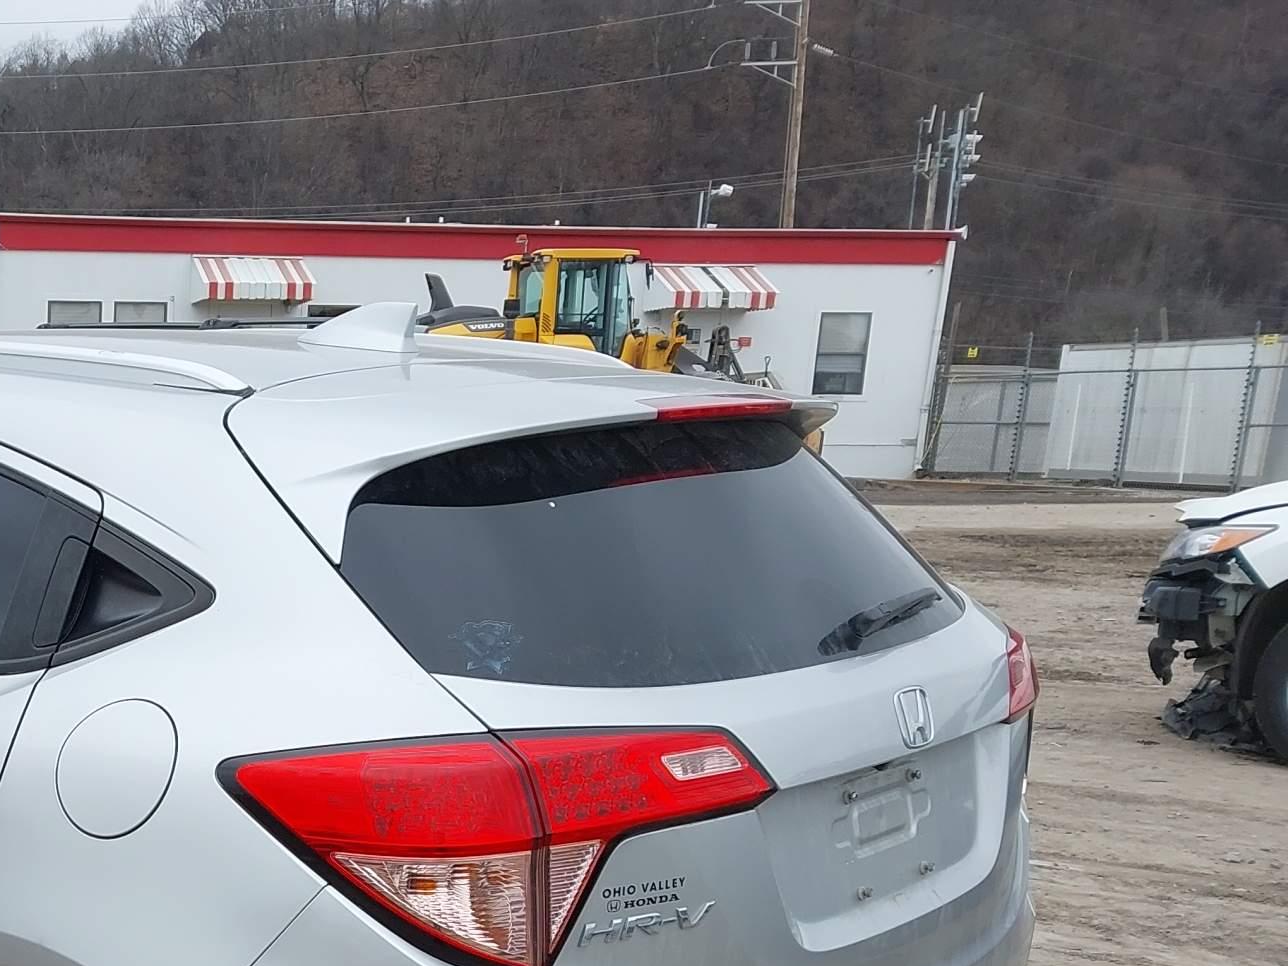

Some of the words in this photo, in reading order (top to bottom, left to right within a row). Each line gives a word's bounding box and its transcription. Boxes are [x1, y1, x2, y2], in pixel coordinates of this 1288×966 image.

[469, 322, 504, 330] VOLVO
[602, 884, 636, 899] OHIO
[641, 877, 686, 893] VALLEY
[623, 893, 680, 909] HONDA
[577, 899, 716, 948] HR-V
